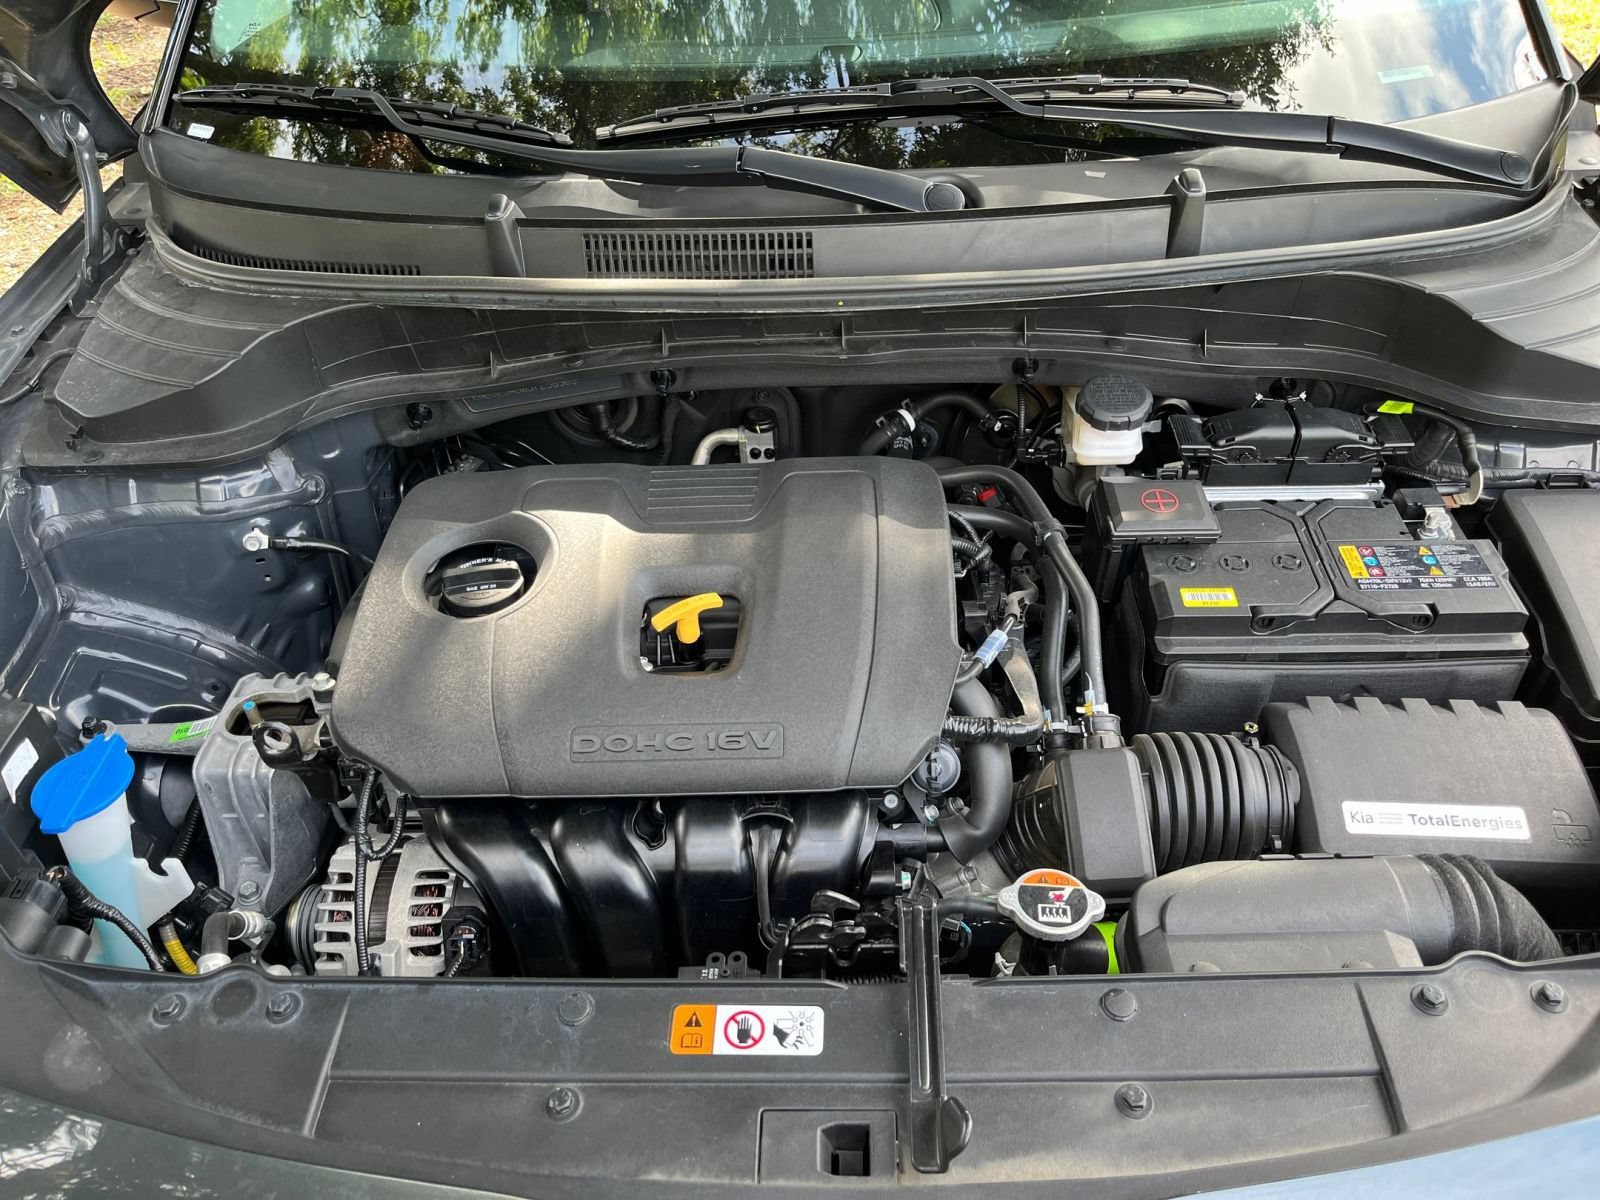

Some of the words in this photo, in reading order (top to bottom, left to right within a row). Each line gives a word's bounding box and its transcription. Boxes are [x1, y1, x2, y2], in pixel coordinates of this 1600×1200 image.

[572, 732, 696, 754] DOHC
[706, 730, 779, 751] 16V
[1350, 811, 1374, 824] Kia
[1408, 813, 1523, 831] TotalEnergies
